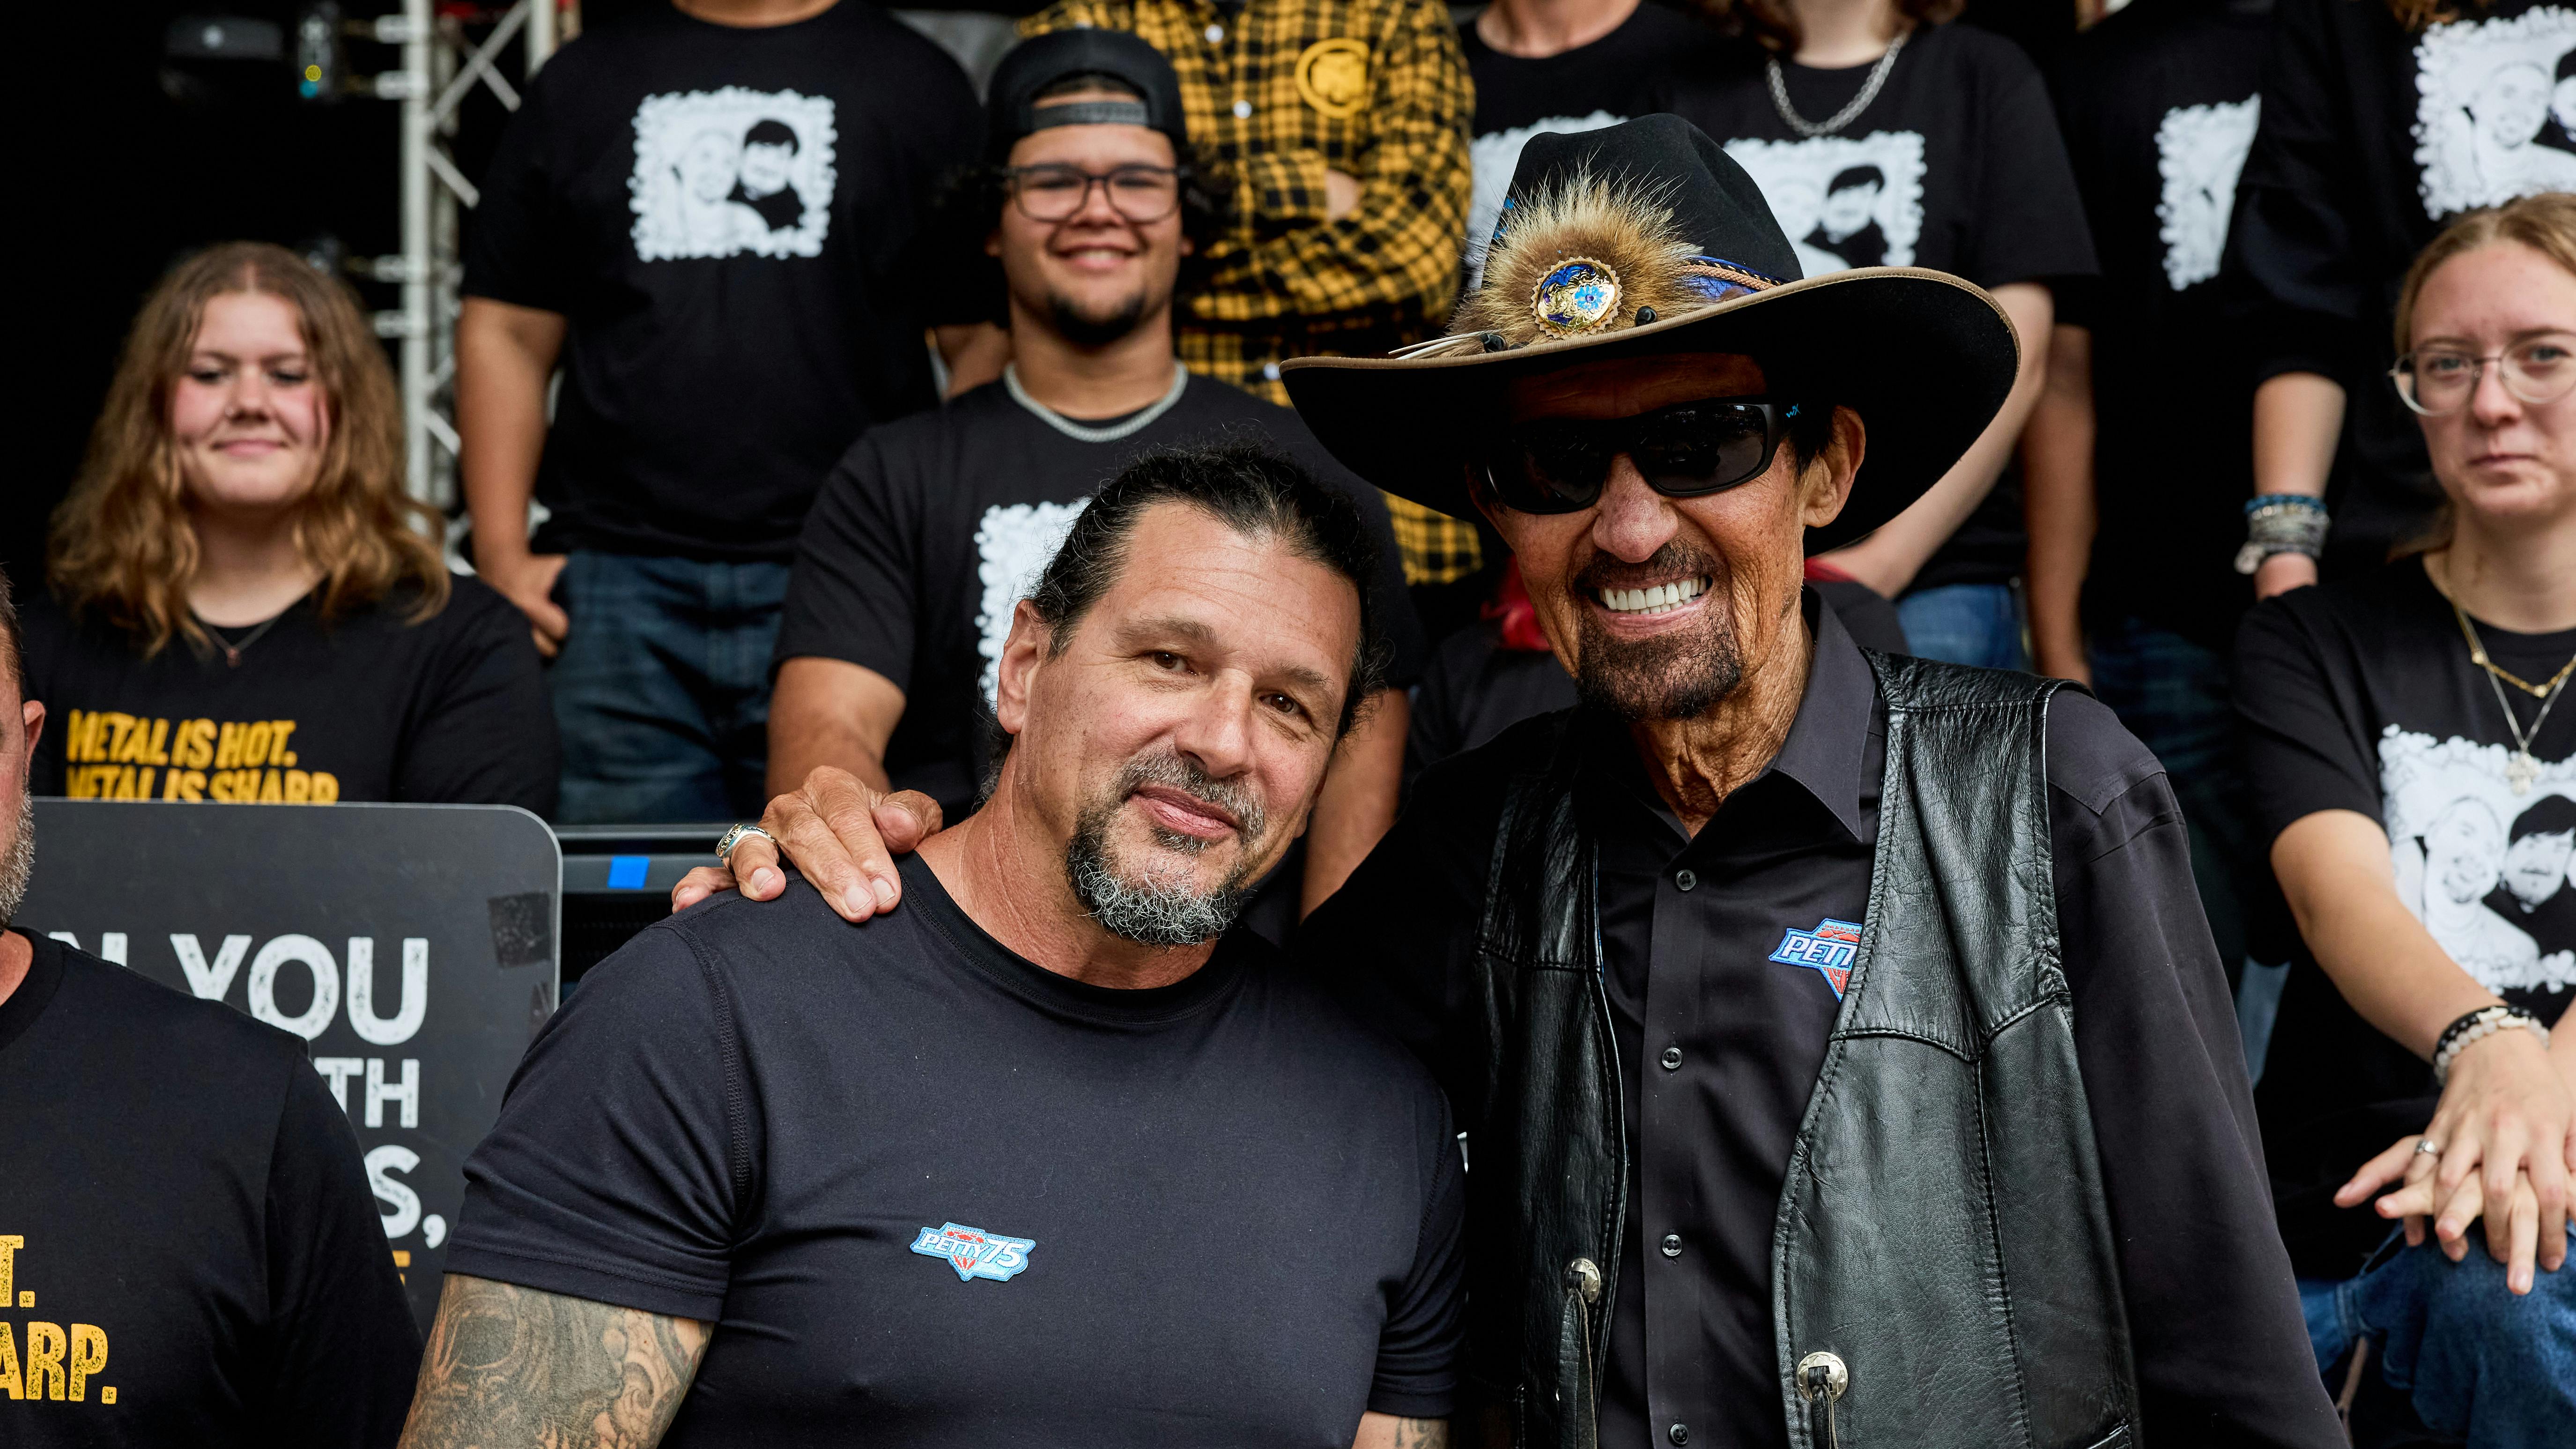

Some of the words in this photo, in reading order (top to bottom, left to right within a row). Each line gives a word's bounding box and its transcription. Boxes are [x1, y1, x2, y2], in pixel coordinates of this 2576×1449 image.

[66, 708, 170, 766] METAL
[170, 718, 217, 770] IS
[215, 720, 297, 769] HOT.
[170, 934, 429, 1045] YOU
